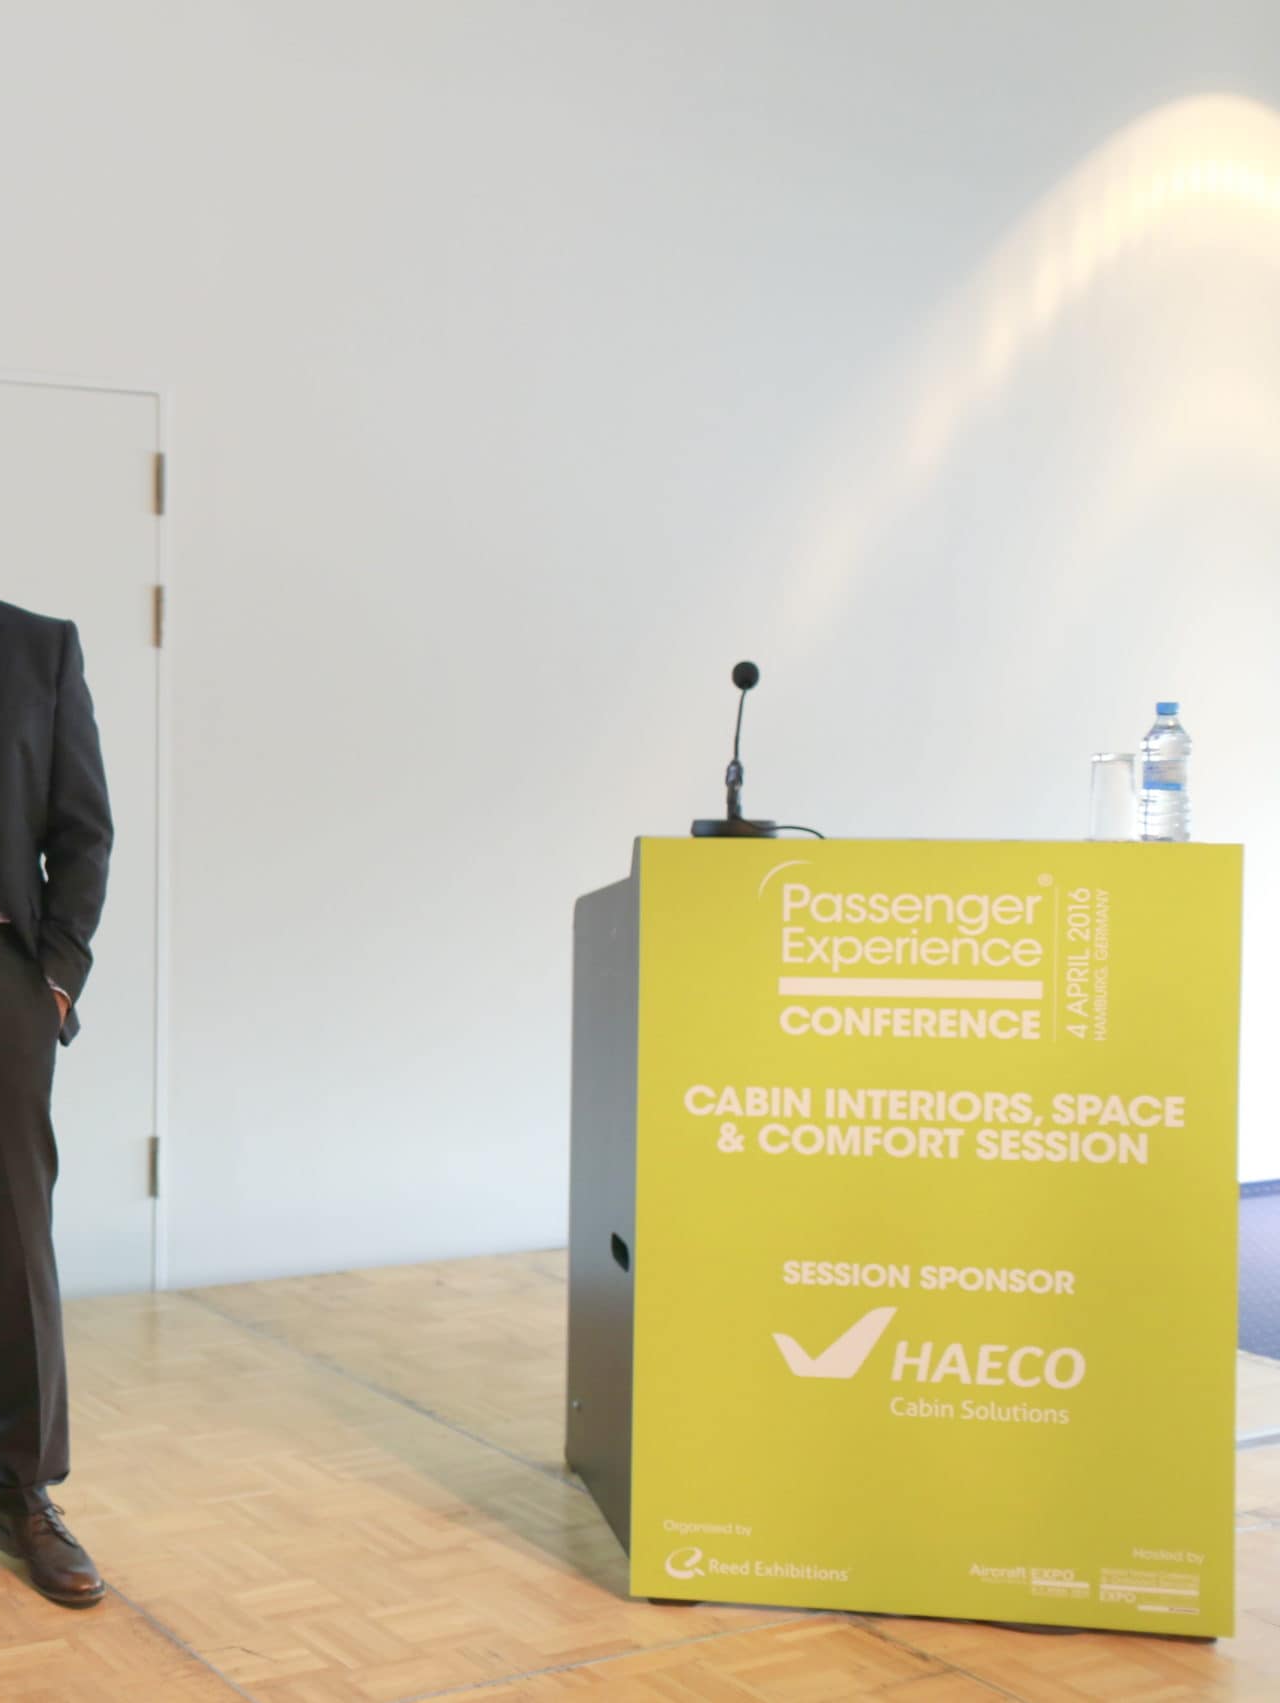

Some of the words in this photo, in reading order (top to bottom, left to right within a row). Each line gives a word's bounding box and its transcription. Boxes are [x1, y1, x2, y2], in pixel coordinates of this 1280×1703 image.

[782, 882, 1042, 936] Passenger
[1067, 886, 1091, 943] 2016
[1095, 888, 1109, 960] GERMANY
[781, 927, 1043, 972] Experience
[1066, 949, 1091, 1018] APRIL
[779, 1005, 1041, 1040] CONFERENCE
[1066, 1022, 1089, 1040] 4
[683, 1085, 811, 1118] CABIN
[825, 1088, 1043, 1128] INTERIORS,
[1052, 1093, 1185, 1128] SPACE
[716, 1121, 745, 1153] &
[757, 1124, 964, 1159] COMFORT
[976, 1129, 1148, 1165] SESSION
[783, 1260, 910, 1289] SESSION
[920, 1265, 1075, 1295] SPONSOR
[890, 1340, 1087, 1390] HAECO
[889, 1396, 954, 1419] Cabin
[961, 1400, 1070, 1425] Solutions
[708, 1558, 750, 1576] Reed
[754, 1560, 848, 1582] Exhibitions
[1031, 1567, 1076, 1582] EXPO
